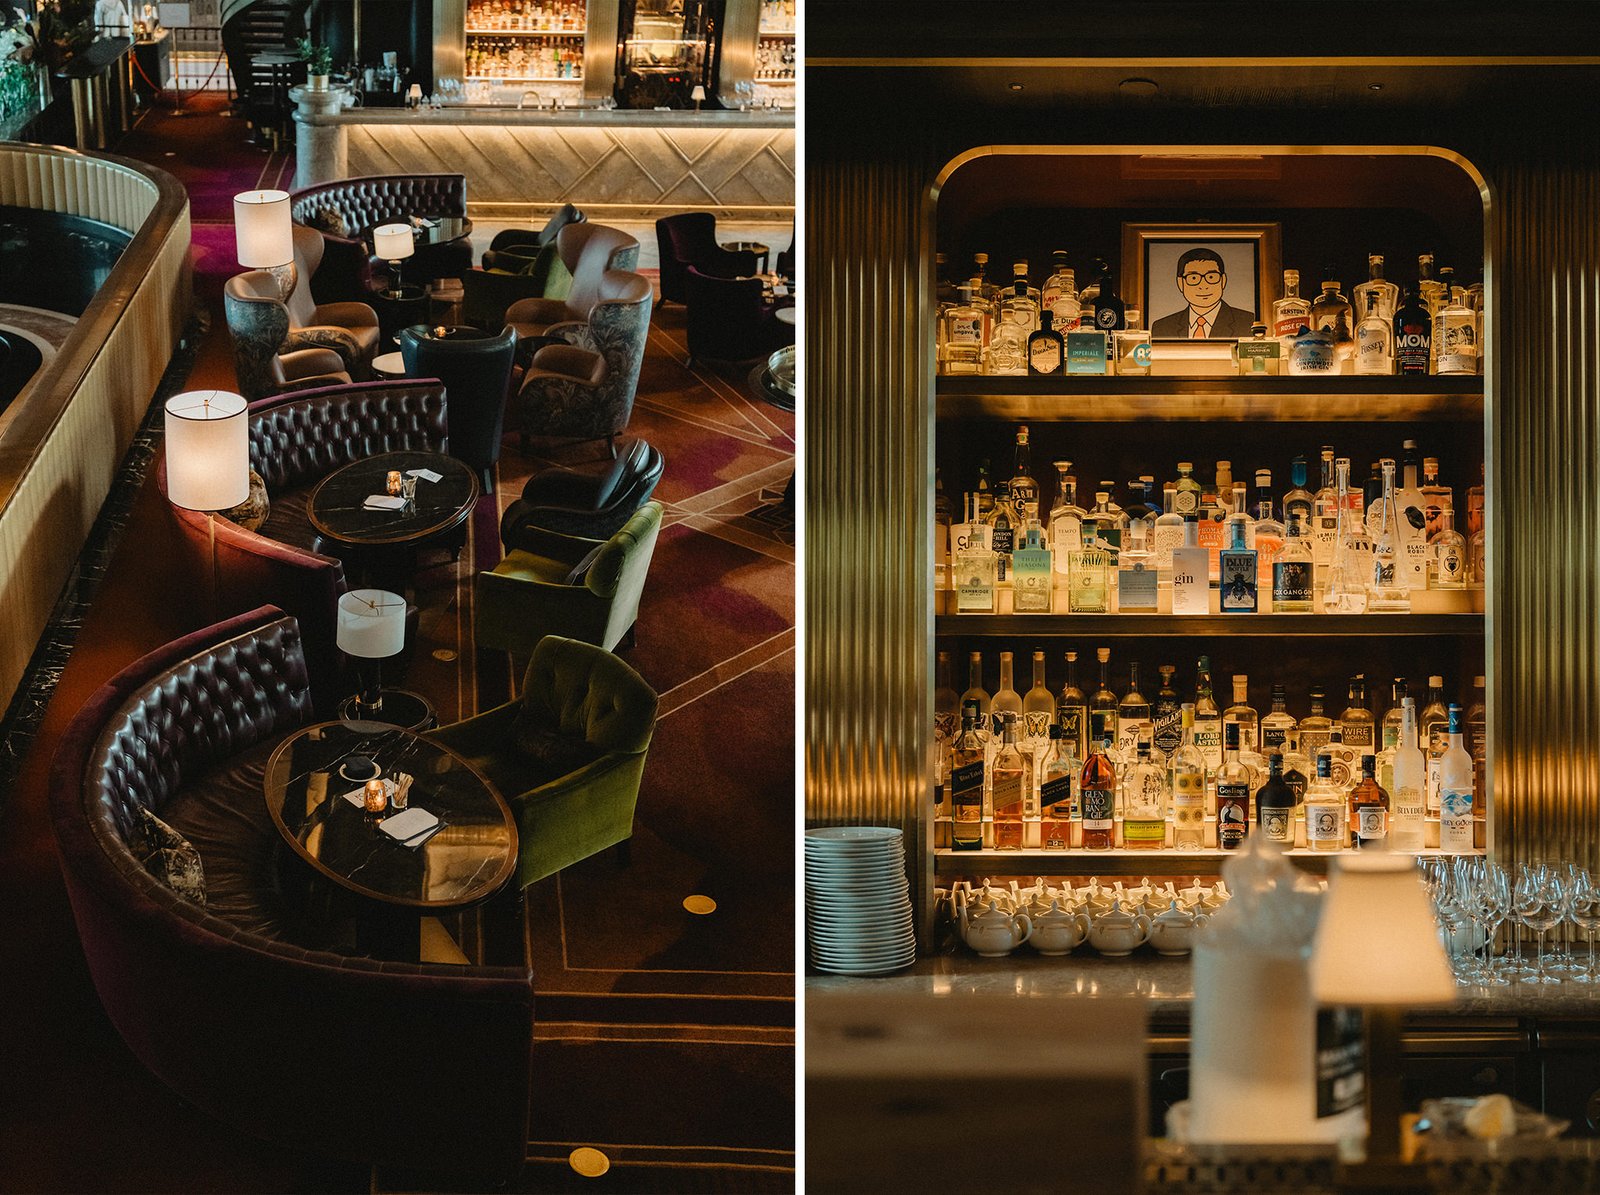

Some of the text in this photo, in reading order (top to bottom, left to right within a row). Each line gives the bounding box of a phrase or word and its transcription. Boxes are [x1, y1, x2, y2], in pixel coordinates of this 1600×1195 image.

[1396, 334, 1432, 349] MOM
[1226, 558, 1253, 567] BLUE
[1174, 572, 1194, 587] gin
[1283, 589, 1303, 597] GANG
[1199, 732, 1220, 740] LORD
[1343, 727, 1369, 736] WIRE
[1084, 790, 1105, 798] GLEN
